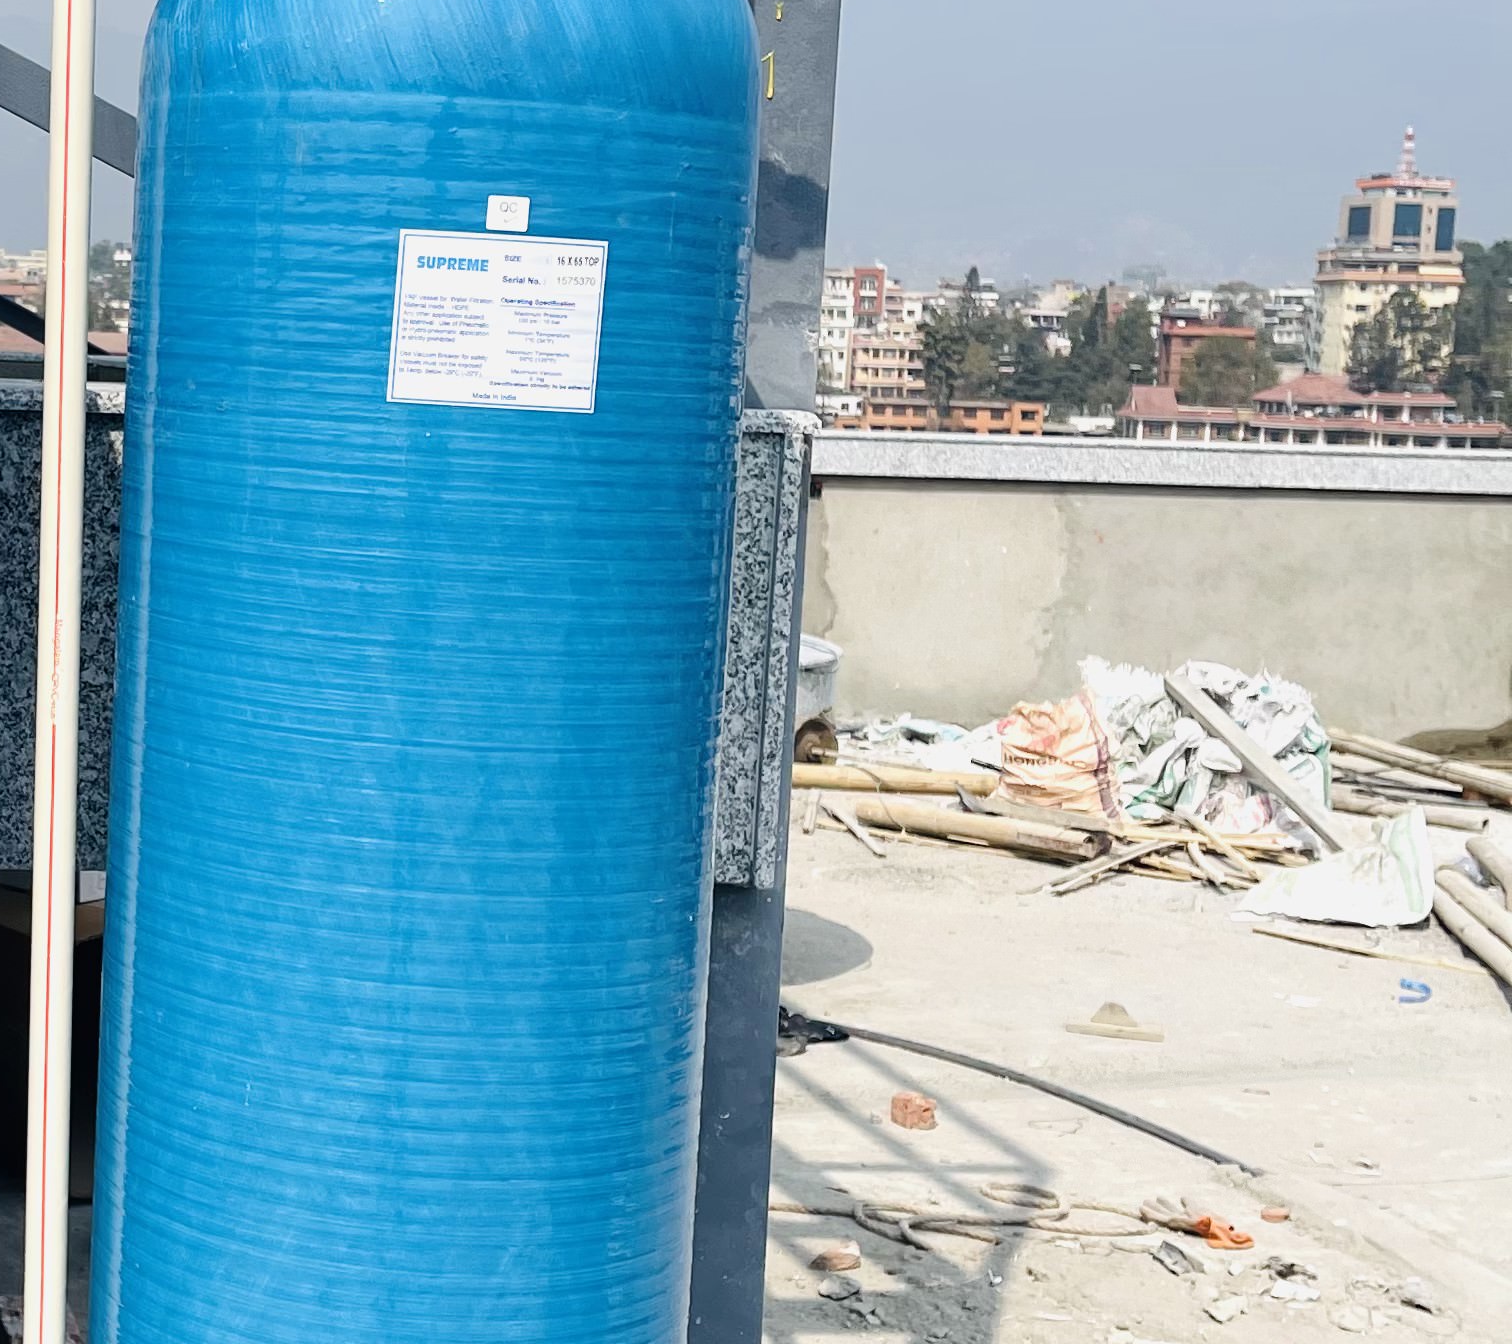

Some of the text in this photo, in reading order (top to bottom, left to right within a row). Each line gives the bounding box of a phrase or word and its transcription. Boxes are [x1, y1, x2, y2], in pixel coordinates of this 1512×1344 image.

[499, 201, 518, 214] QC
[416, 256, 489, 272] SUPREME
[502, 275, 525, 284] Serial
